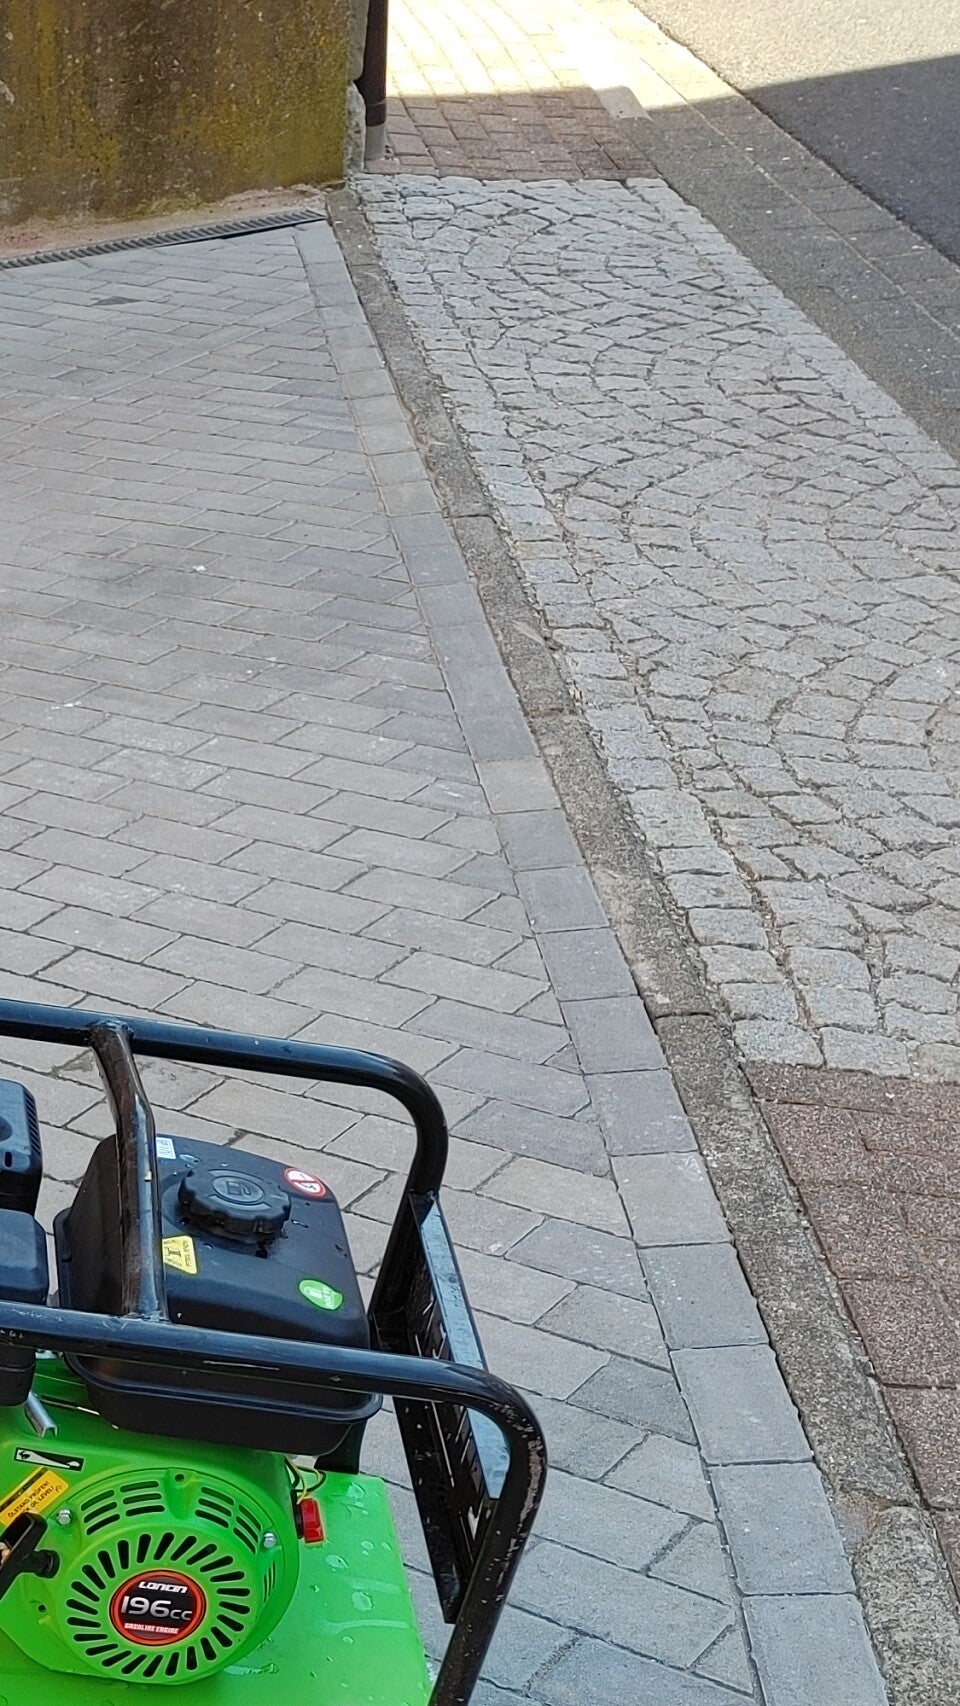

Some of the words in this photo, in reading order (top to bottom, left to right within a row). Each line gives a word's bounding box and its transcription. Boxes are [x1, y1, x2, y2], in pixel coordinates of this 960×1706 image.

[120, 1595, 193, 1621] 196cc
[124, 1622, 155, 1632] GASOLINE
[155, 1626, 180, 1635] ENGINE
